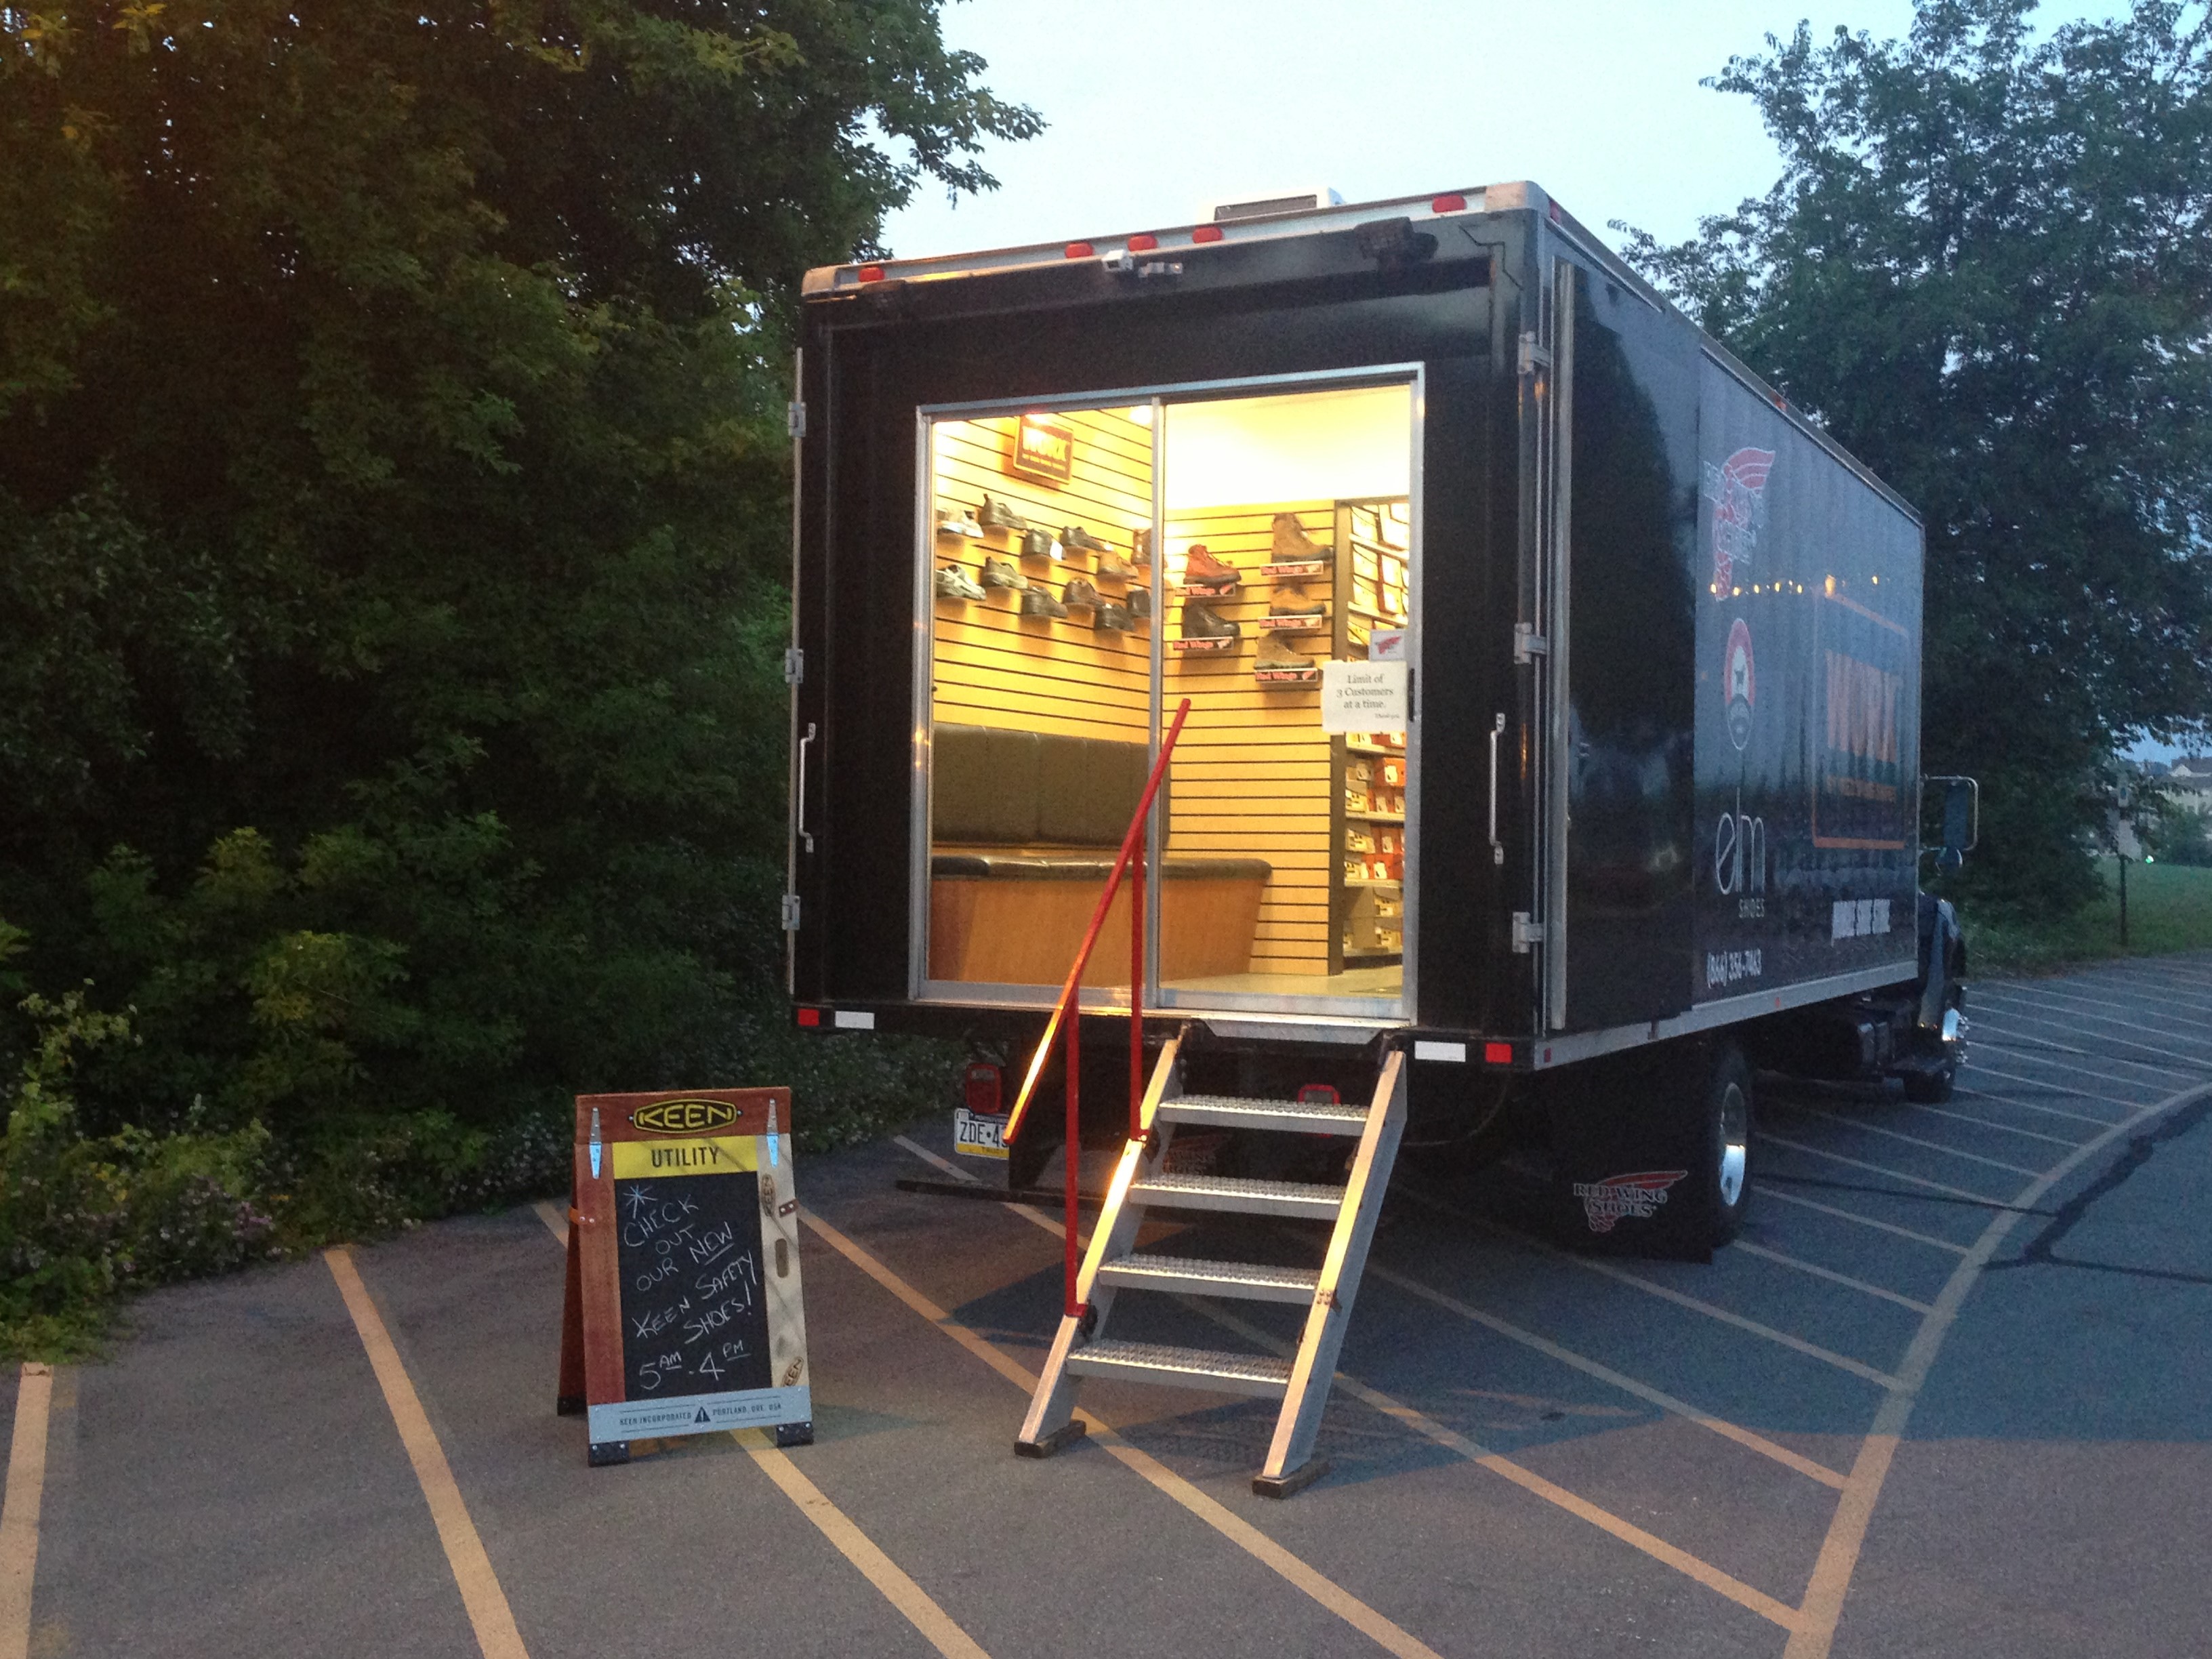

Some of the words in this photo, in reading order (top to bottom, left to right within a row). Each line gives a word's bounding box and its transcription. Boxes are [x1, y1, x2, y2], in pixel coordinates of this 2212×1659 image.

[1347, 674, 1371, 683] Limit
[1374, 673, 1385, 683] of
[1336, 689, 1343, 698] 3
[1345, 687, 1393, 696] Customers
[1343, 701, 1352, 709] at
[638, 1103, 733, 1129] KEEN
[651, 1146, 720, 1168] UTILITY
[1573, 1183, 1611, 1197] RED
[1613, 1184, 1668, 1204] WING
[1591, 1199, 1654, 1218] SHOES
[623, 1194, 699, 1247] CHECK
[655, 1223, 695, 1254] OUT
[636, 1257, 679, 1292] OUR
[689, 1221, 733, 1265] NEW
[632, 1295, 691, 1339] KEEN
[695, 1250, 758, 1300] SAFETY
